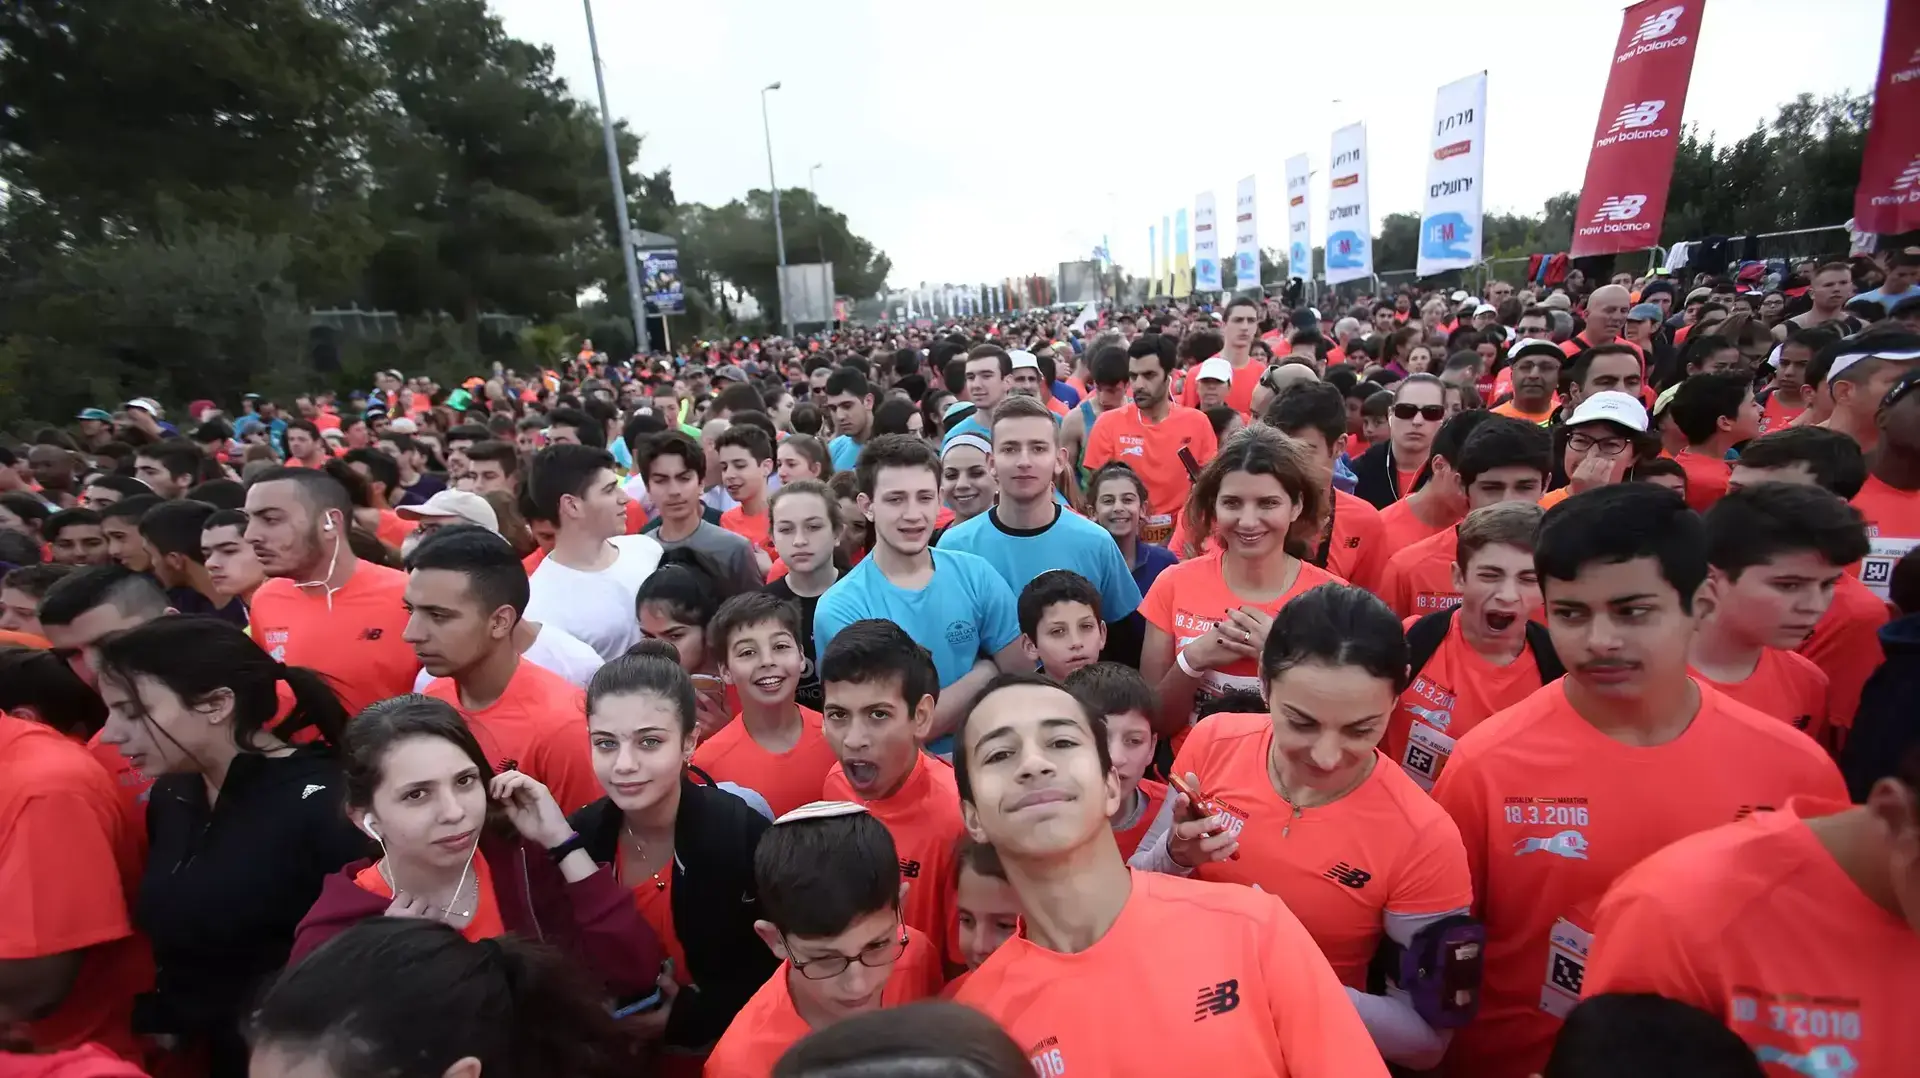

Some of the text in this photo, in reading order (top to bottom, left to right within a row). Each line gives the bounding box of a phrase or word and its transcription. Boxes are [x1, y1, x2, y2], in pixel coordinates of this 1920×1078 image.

[1616, 35, 1688, 64] new balance
[1596, 128, 1669, 148] new balance
[1579, 222, 1651, 236] new balance
[1175, 614, 1215, 632] 18.3.201
[1557, 797, 1588, 805] MARATHON
[1504, 805, 1589, 826] 18.3.2016
